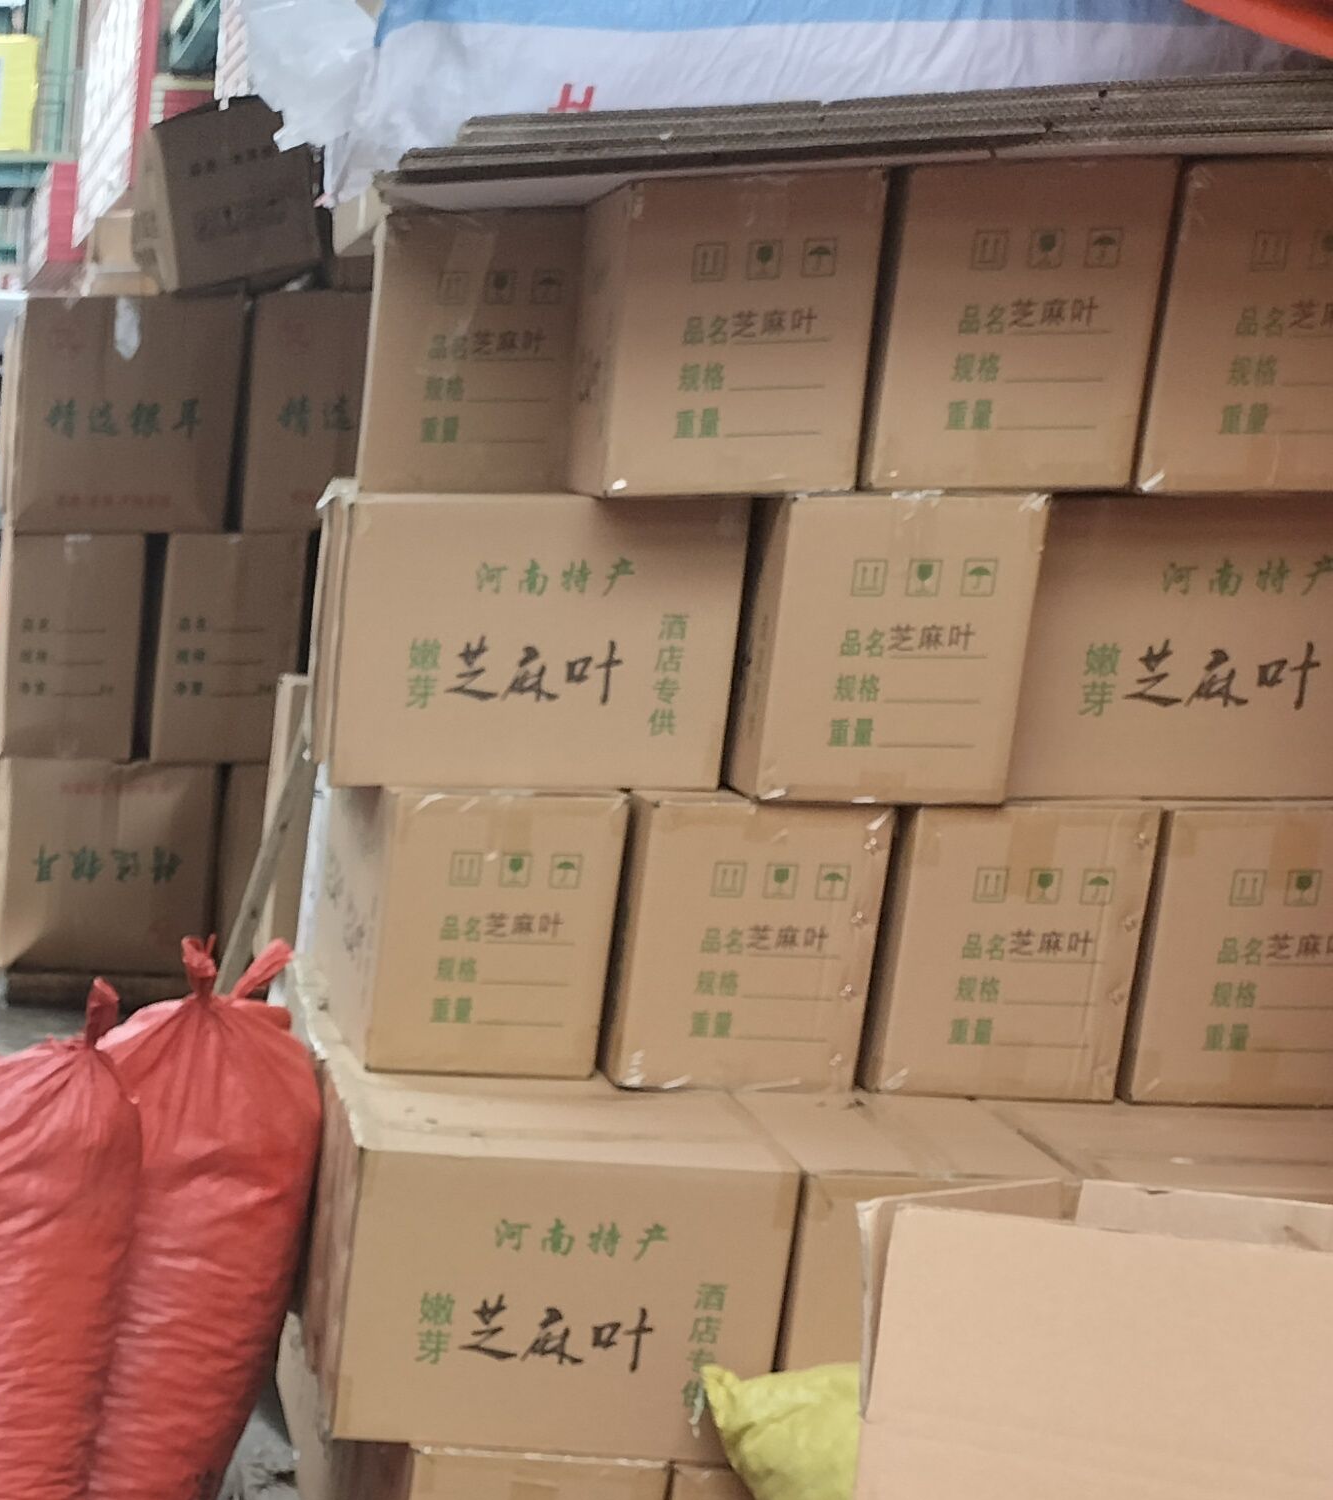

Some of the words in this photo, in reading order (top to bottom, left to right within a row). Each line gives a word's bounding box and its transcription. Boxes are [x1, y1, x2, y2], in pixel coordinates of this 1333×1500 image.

[681, 307, 818, 347] 品名芝麻叶
[957, 297, 1100, 336] 品名芝麻叶
[1235, 300, 1333, 337] 品名芝
[677, 362, 725, 393] 规格
[951, 353, 1001, 383] 规格
[1227, 355, 1279, 387] 规格
[673, 407, 721, 439] 重量
[944, 398, 994, 431] 重量
[476, 557, 636, 597] 河南特产
[1162, 555, 1333, 597] 河南特产
[838, 622, 977, 658] 品名芝麻叶
[405, 637, 443, 710] 嫩芽
[444, 635, 624, 706] 芝麻叶
[647, 612, 691, 737] 酒店专供
[1078, 641, 1122, 719] 嫩芽
[1122, 638, 1321, 710] 芝麻叶
[834, 673, 881, 703] 规格
[827, 717, 875, 748] 重量
[439, 912, 565, 942] 品名芝麻叶
[699, 924, 829, 955] 品名芝麻叶
[961, 930, 1095, 962] 品名芝麻叶
[1217, 932, 1333, 966] 品名芝麻
[435, 956, 478, 984] 规格
[695, 969, 740, 998] 规格
[954, 975, 1002, 1003] 规格
[1210, 979, 1258, 1009] 规格
[947, 1017, 994, 1047] 重量
[1202, 1022, 1251, 1053] 重量
[494, 1218, 670, 1262] 河南特产
[415, 1291, 455, 1367] 嫩芽
[458, 1293, 656, 1373] 芝麻叶
